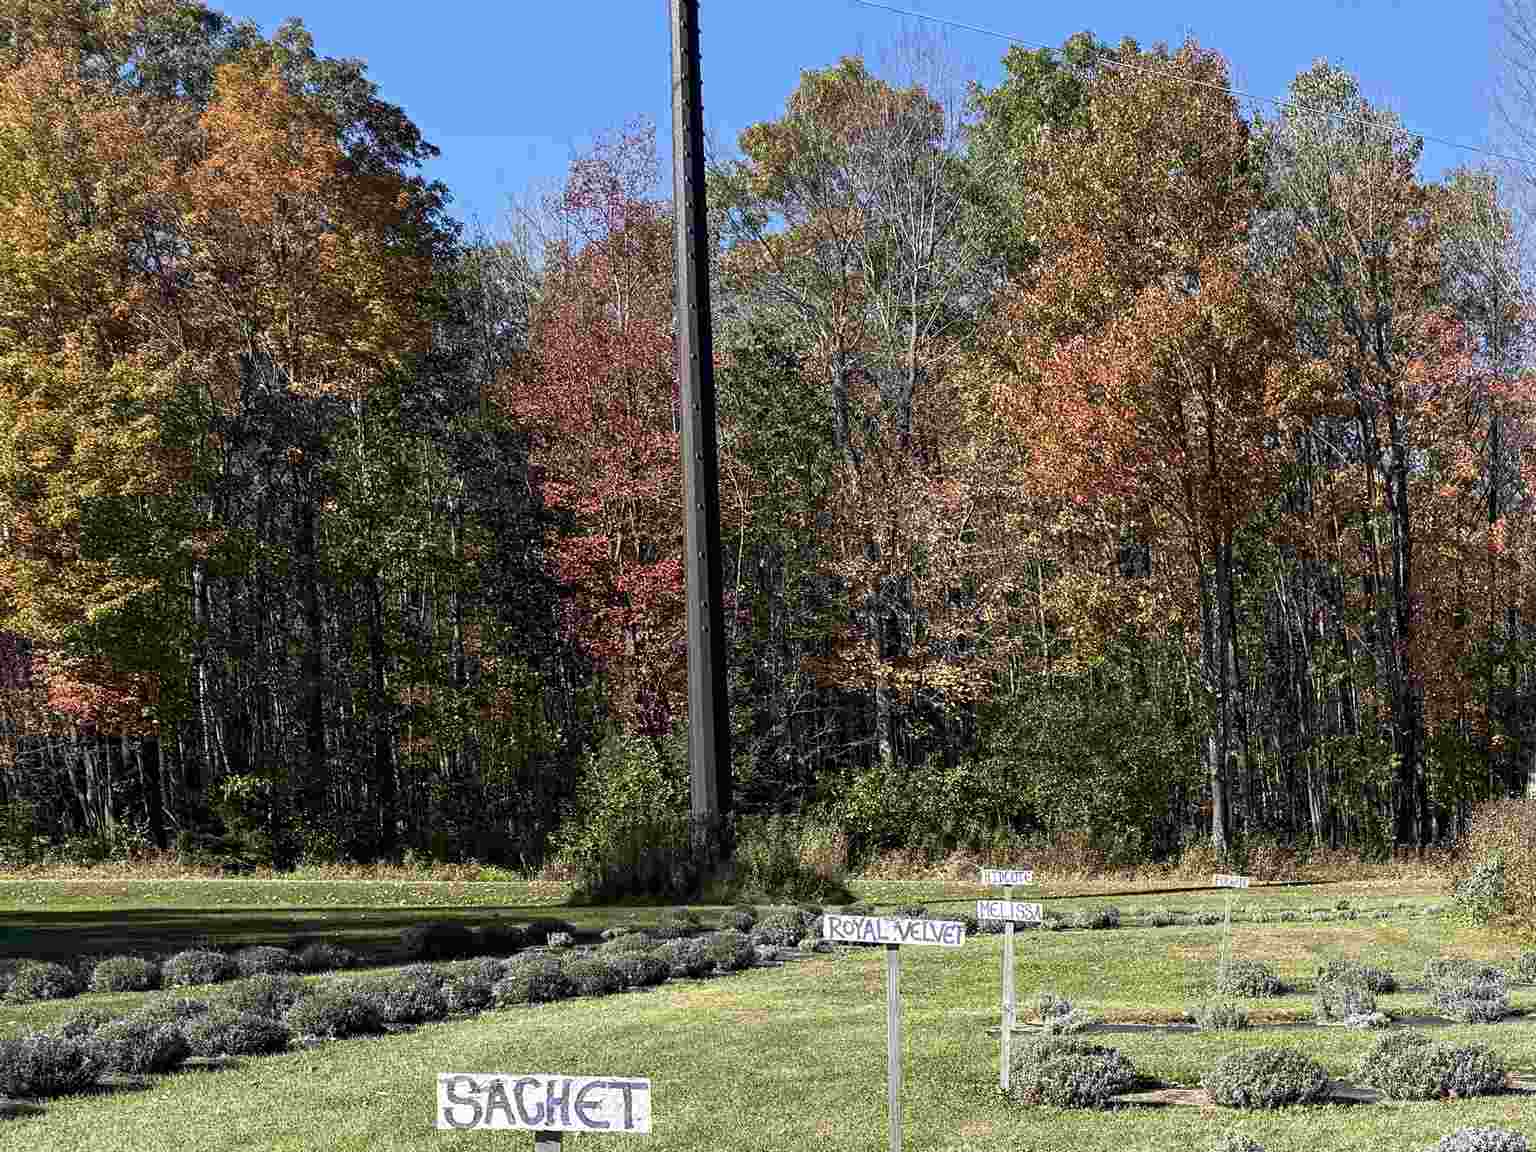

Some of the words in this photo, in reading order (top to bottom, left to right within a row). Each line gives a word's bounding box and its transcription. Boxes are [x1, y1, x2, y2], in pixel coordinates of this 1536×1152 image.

[979, 902, 1041, 920] MELISSA
[828, 917, 889, 943] ROYAL
[896, 920, 962, 944] VELVET
[443, 1075, 648, 1129] SACHET
